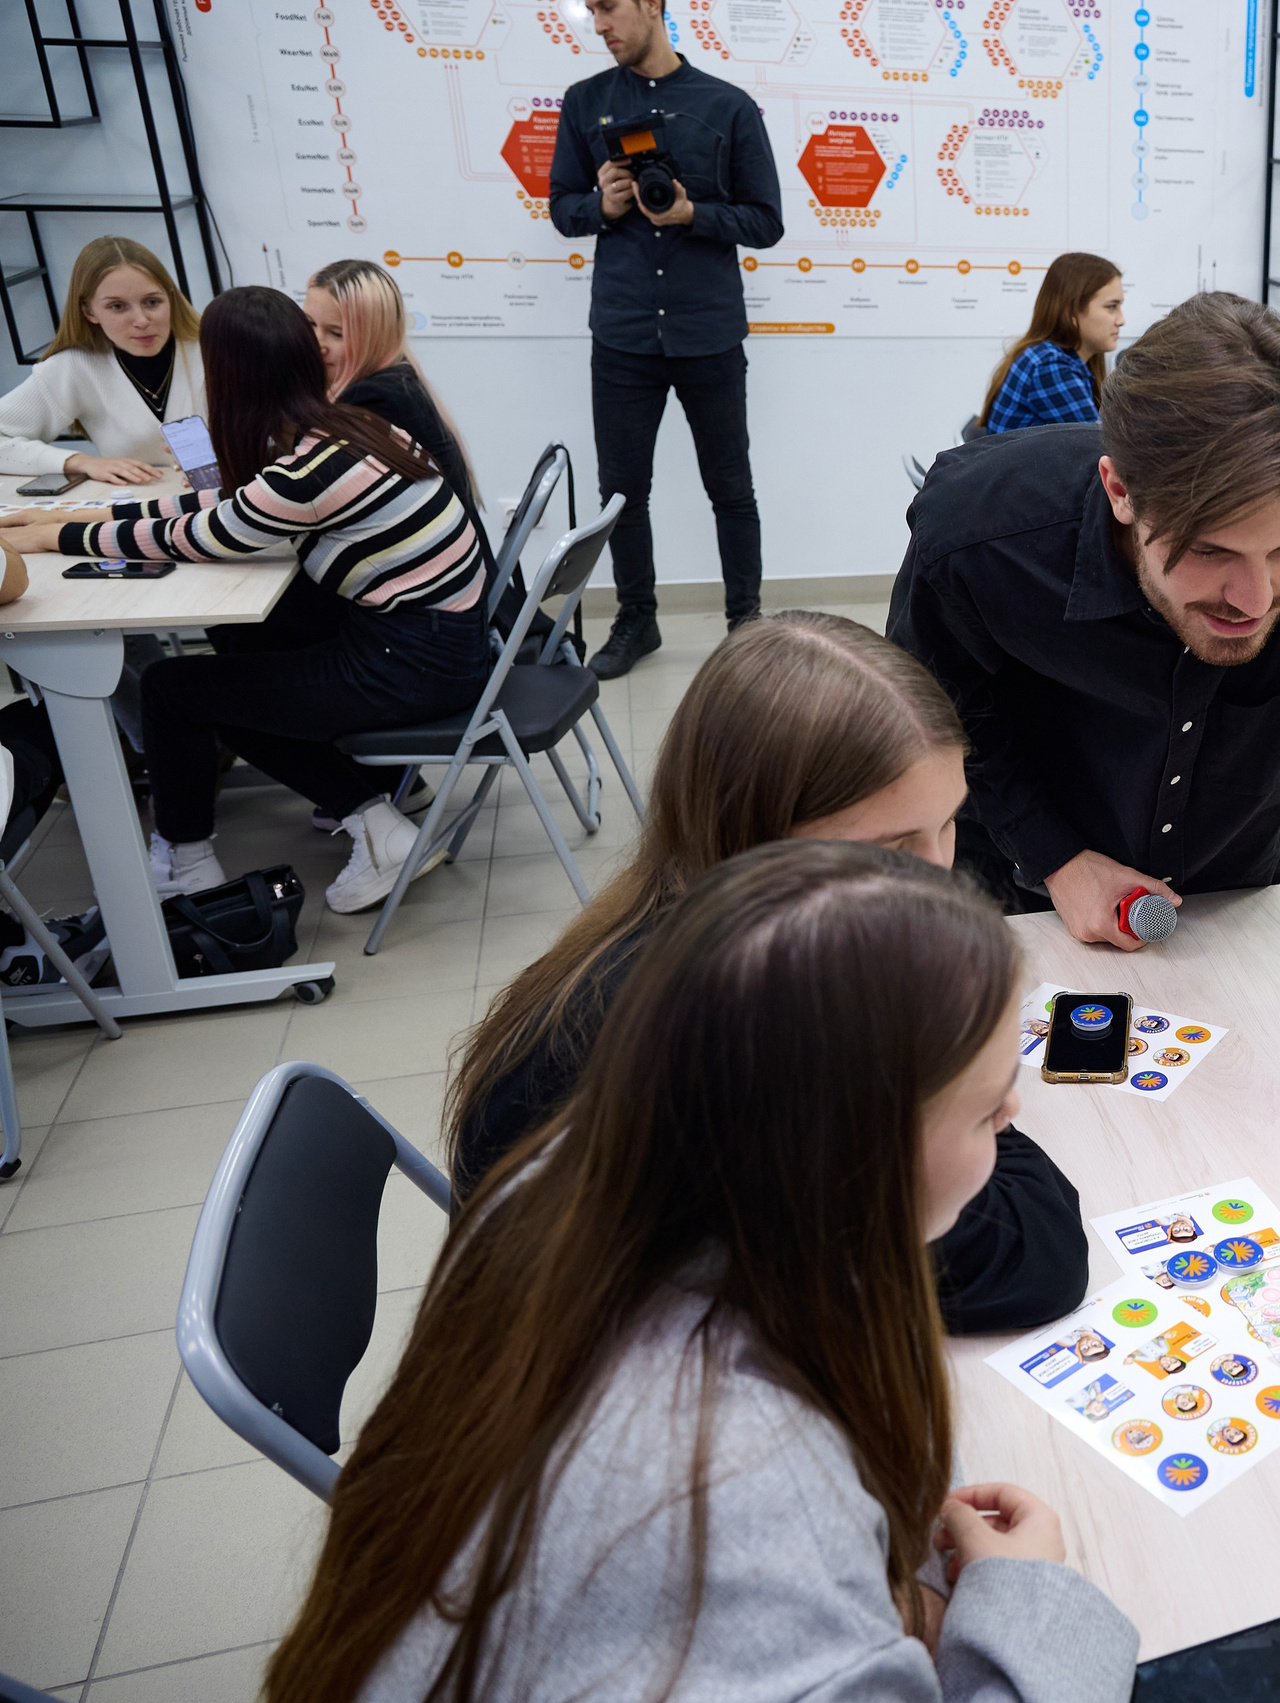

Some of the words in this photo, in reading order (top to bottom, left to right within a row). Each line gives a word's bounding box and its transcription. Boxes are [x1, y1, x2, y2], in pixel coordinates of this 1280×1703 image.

[275, 13, 307, 21] FoodNet
[279, 49, 313, 57] WearNet
[291, 84, 318, 92] EduNet
[298, 119, 324, 127] EcoNet
[296, 153, 330, 161] GameNet
[307, 220, 340, 228] SportNet
